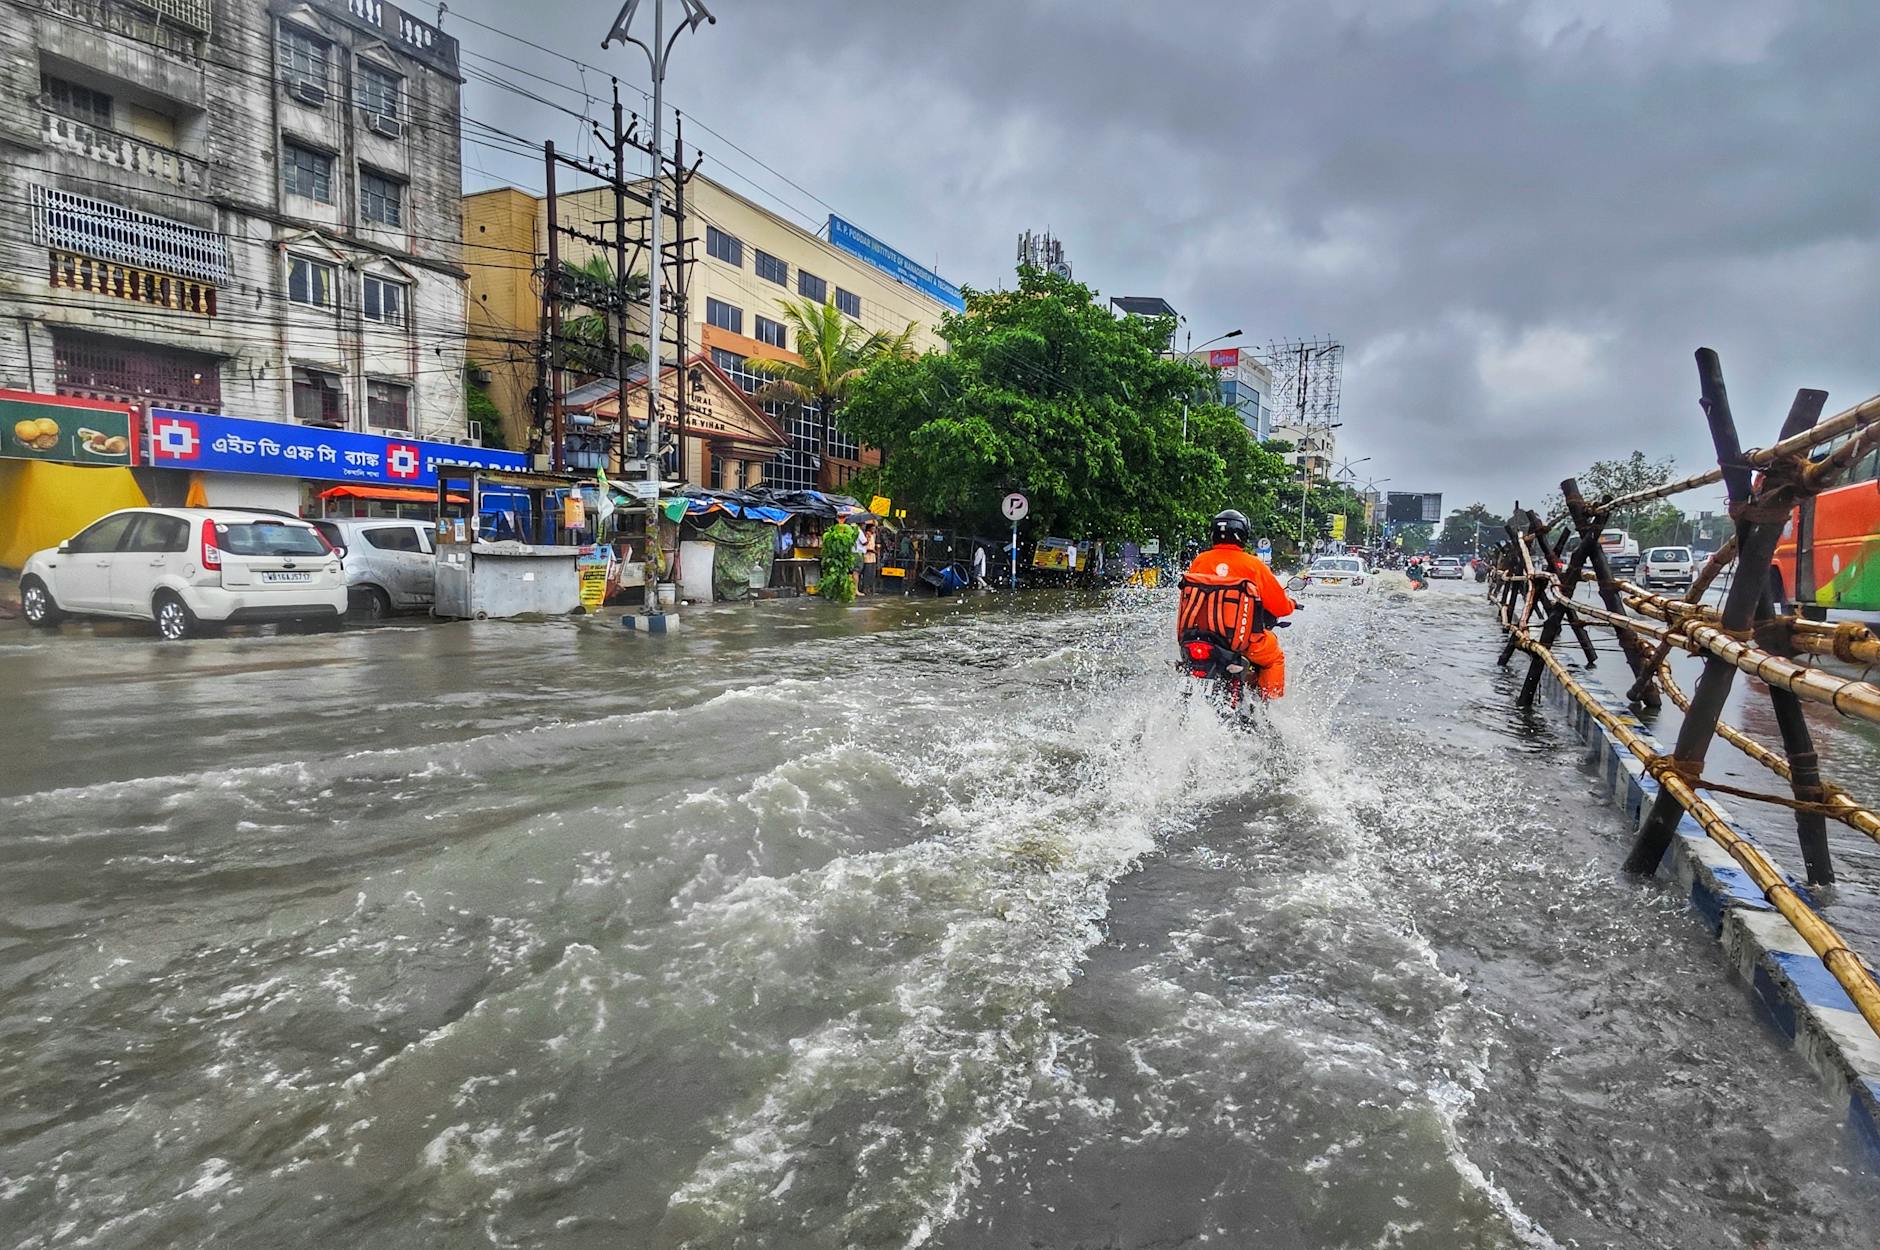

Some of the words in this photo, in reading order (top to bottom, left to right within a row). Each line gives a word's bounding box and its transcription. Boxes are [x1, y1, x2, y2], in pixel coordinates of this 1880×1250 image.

[660, 413, 697, 427] PODAR
[700, 420, 725, 431] VIHAR
[212, 433, 256, 454] এইচ
[258, 438, 281, 457] ডি
[283, 445, 314, 461] এফ
[317, 444, 337, 464] সি
[1008, 498, 1023, 516] P
